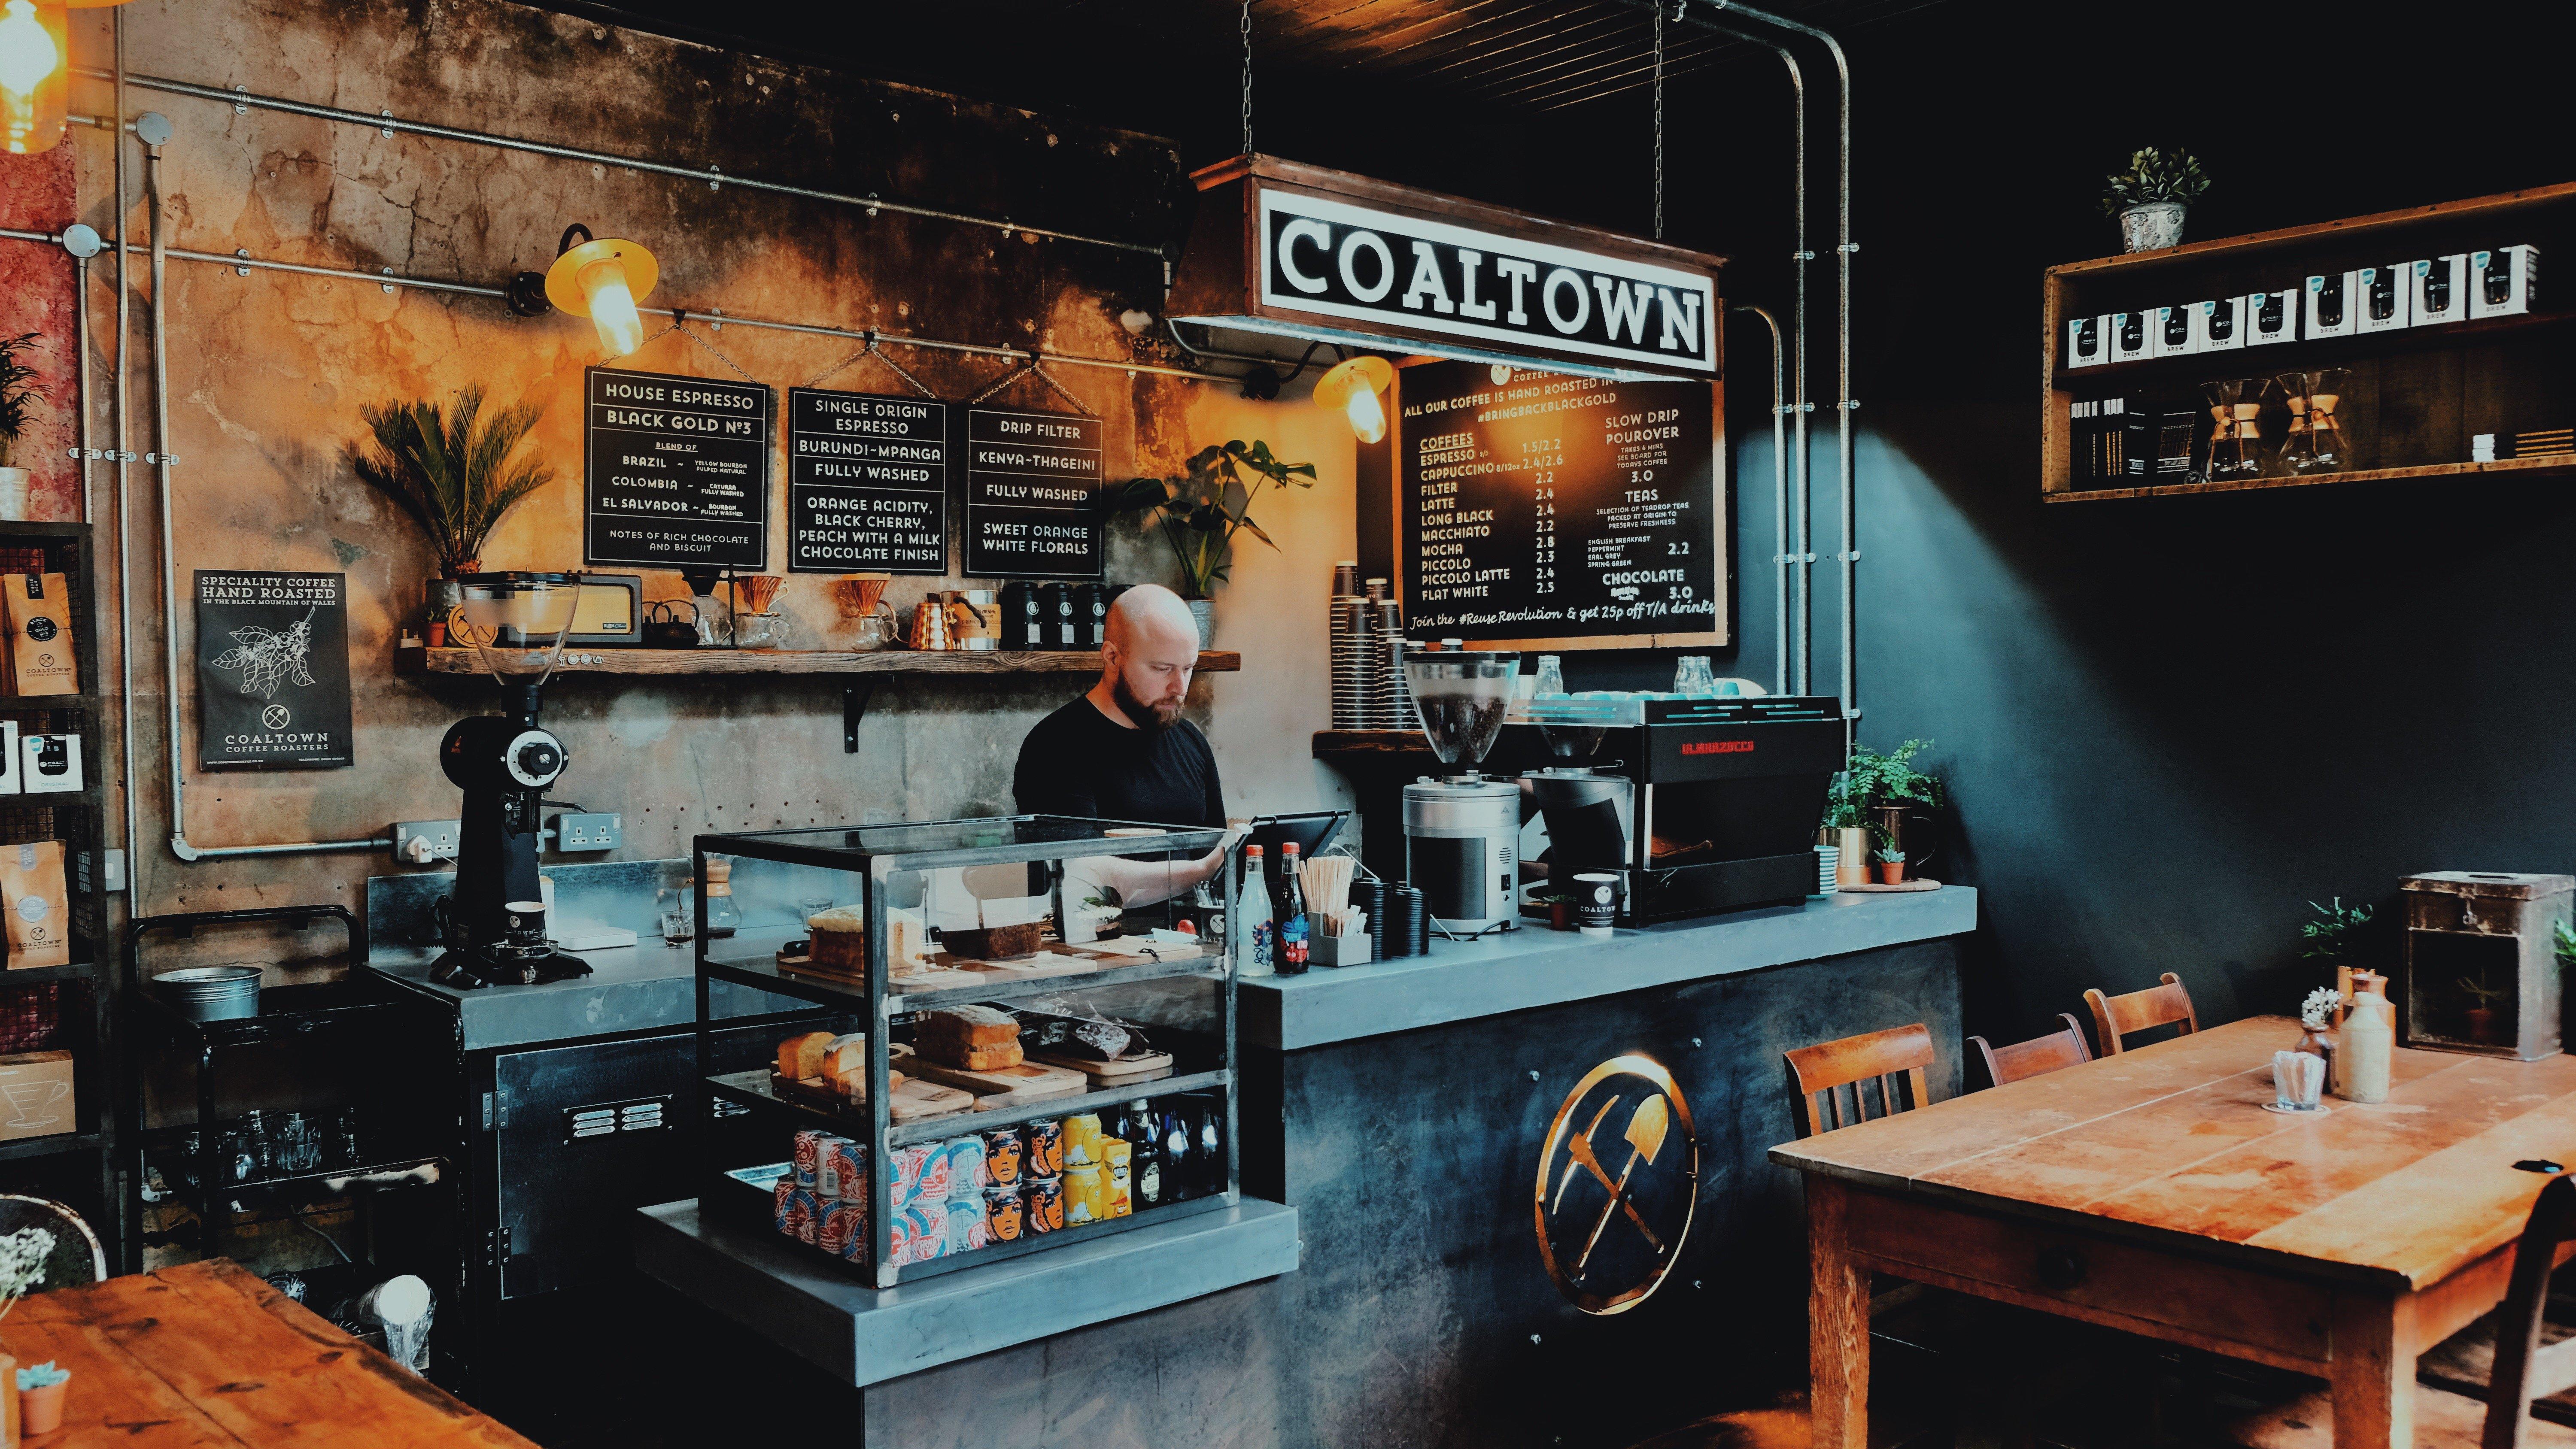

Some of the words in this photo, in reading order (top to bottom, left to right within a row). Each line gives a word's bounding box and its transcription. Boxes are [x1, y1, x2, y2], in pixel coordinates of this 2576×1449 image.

[1278, 219, 1702, 352] COALTOWN
[1513, 371, 1548, 382] COFFEE
[606, 384, 665, 401] HOUSE
[672, 390, 753, 409] ESPRESSO
[1404, 405, 1422, 417] ALL
[1425, 400, 1447, 413] OUR
[1450, 394, 1490, 409] COFFEE
[1495, 391, 1504, 403] IS
[1508, 387, 1540, 401] HAND
[1544, 377, 1597, 395] ROASTED
[815, 400, 869, 414] SINGLE
[875, 404, 927, 418] ORIGIN
[1477, 392, 1616, 423] #BRINGBACKBLACKGOLD
[608, 410, 664, 427] BLACK
[671, 416, 719, 431] GOLD
[836, 418, 908, 434] ESPRESSO
[1605, 413, 1642, 428] SLOW
[1648, 409, 1679, 423] DRIP
[1001, 421, 1032, 434] DRIP
[1037, 424, 1081, 439] FILTER
[1606, 426, 1679, 445] POUROVER
[1420, 433, 1473, 450] COFFEES
[1421, 449, 1475, 466] ESPRESSO
[1522, 438, 1561, 454] 1.5/2.2
[1630, 452, 1652, 460] BOARD
[623, 455, 667, 468] BRAZIL
[1421, 462, 1494, 481] CAPPUCCINO
[1523, 454, 1563, 470] 2.4/2.6
[1616, 461, 1641, 469] TODAYS
[1643, 458, 1667, 466] COFFEE
[815, 463, 861, 477] FULLY
[867, 467, 929, 481] WASHED
[1631, 470, 1653, 483] 3.0
[612, 476, 677, 490] COLOMBIA
[1421, 482, 1458, 496] FILTER
[1536, 471, 1553, 484] 2.2
[987, 484, 1027, 498] FULLY
[1032, 487, 1088, 501] WASHED
[1422, 497, 1455, 511] LATTE
[1536, 488, 1554, 500] 2.4
[1625, 489, 1659, 503] TEAS
[603, 497, 617, 507] EL
[621, 498, 688, 512] SALVADOR
[807, 497, 867, 510] ORANGE
[873, 500, 933, 515] ACIDITY,
[1596, 506, 1629, 515] SELECTION
[815, 514, 861, 526] BLACK
[867, 516, 925, 530] CHERRY,
[1422, 513, 1452, 526] LONG
[1456, 509, 1493, 524] BLACK
[1536, 503, 1554, 516] 2.4
[984, 523, 1028, 535] SWEET
[1033, 525, 1088, 539] ORANGE
[1422, 525, 1490, 542] MACCHIATO
[1536, 520, 1554, 533] 2.2
[1608, 521, 1638, 529] PRESERVE
[1640, 518, 1676, 527] FRESHNESS
[610, 530, 643, 539] NOTES
[664, 533, 687, 541] RICH
[691, 534, 749, 544] CHOCOLATE
[799, 530, 846, 543] PEACH
[852, 531, 888, 543] WITH
[894, 533, 902, 544] A
[909, 533, 940, 545] MILK
[1615, 536, 1651, 544] BREAKFAST
[650, 543, 670, 551] AND
[674, 543, 712, 552] BISCUIT
[801, 546, 888, 560] CHOCOLATE
[894, 549, 938, 561] FINISH
[983, 539, 1026, 552] WHITE
[1031, 541, 1088, 554] FLORALS
[1422, 543, 1463, 557] MOCHA
[1536, 536, 1554, 549] 2.8
[1588, 545, 1625, 553] PEPPERMINT
[1668, 542, 1689, 555] 2.2
[1422, 558, 1471, 572] PICCOLO
[1536, 550, 1554, 563] 2.3
[202, 576, 282, 586] SPECIALITY
[287, 578, 335, 587] COFFEE
[1422, 572, 1470, 585] PICCOLO
[1475, 568, 1510, 582] LATTE
[1536, 567, 1554, 579] 2.4
[1602, 569, 1685, 585] CHOCOLATE
[202, 587, 253, 598] HAND
[260, 588, 336, 599] ROASTED
[1422, 588, 1449, 601] FLAT
[1452, 585, 1488, 598] WHITE
[1537, 581, 1554, 594] 2.5
[1669, 586, 1693, 599] 3.0
[1410, 615, 1435, 630] Join
[1437, 613, 1455, 625] the
[1567, 607, 1576, 620] &
[1579, 605, 1599, 622] get
[1602, 606, 1624, 621] 25p
[1626, 602, 1645, 619] off
[1646, 601, 1667, 618] T/A
[1671, 599, 1715, 614] drinks
[225, 733, 328, 745] COALTOWN
